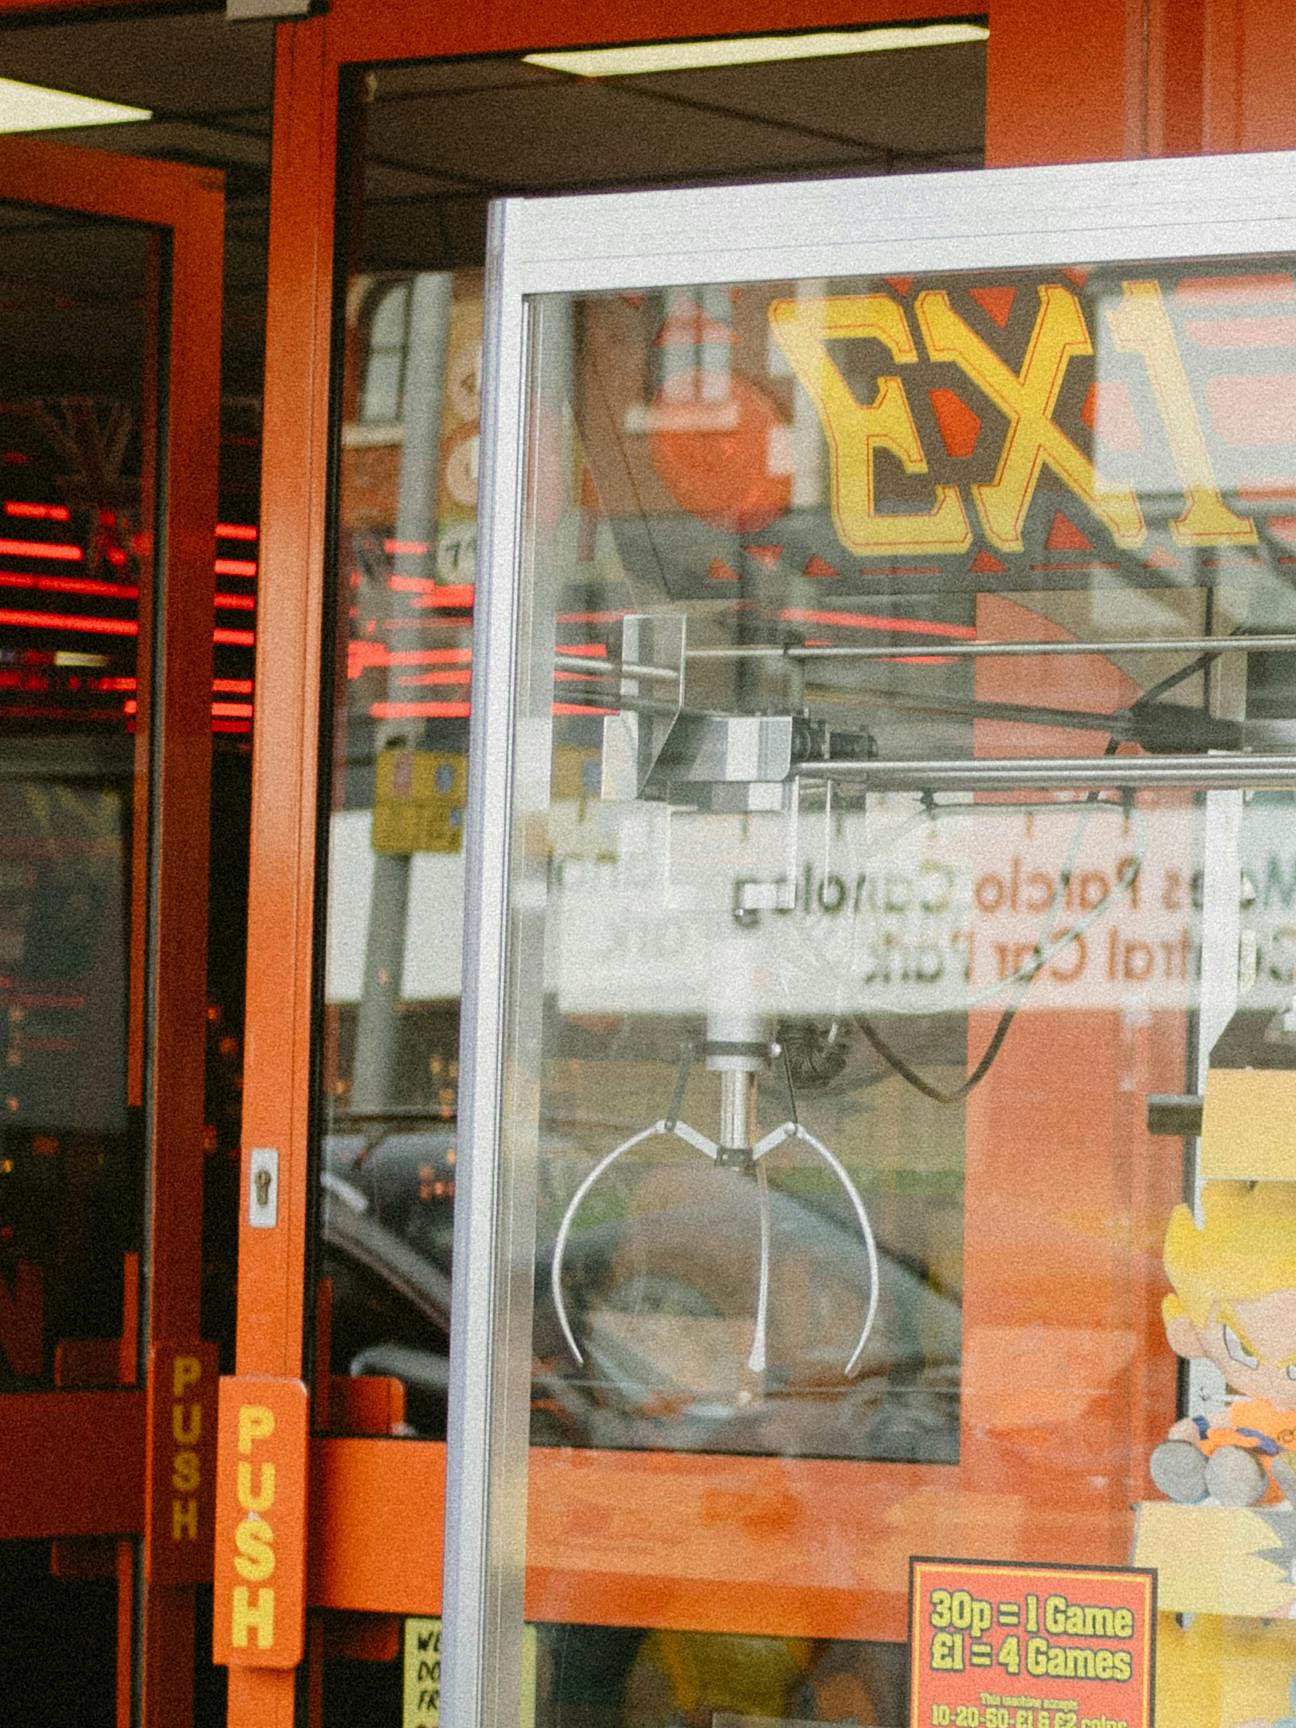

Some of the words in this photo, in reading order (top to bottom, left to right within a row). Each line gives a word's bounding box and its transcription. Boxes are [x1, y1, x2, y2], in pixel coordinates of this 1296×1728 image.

[172, 1355, 201, 1541] PUSH
[230, 1403, 276, 1650] PUSH
[929, 1588, 993, 1638] 30p
[998, 1601, 1020, 1627] =
[1024, 1592, 1040, 1634] 1
[1044, 1594, 1134, 1640] Game
[929, 1630, 965, 1672] £1
[970, 1642, 993, 1667] =
[997, 1634, 1020, 1676] 4
[1026, 1635, 1132, 1683] Games
